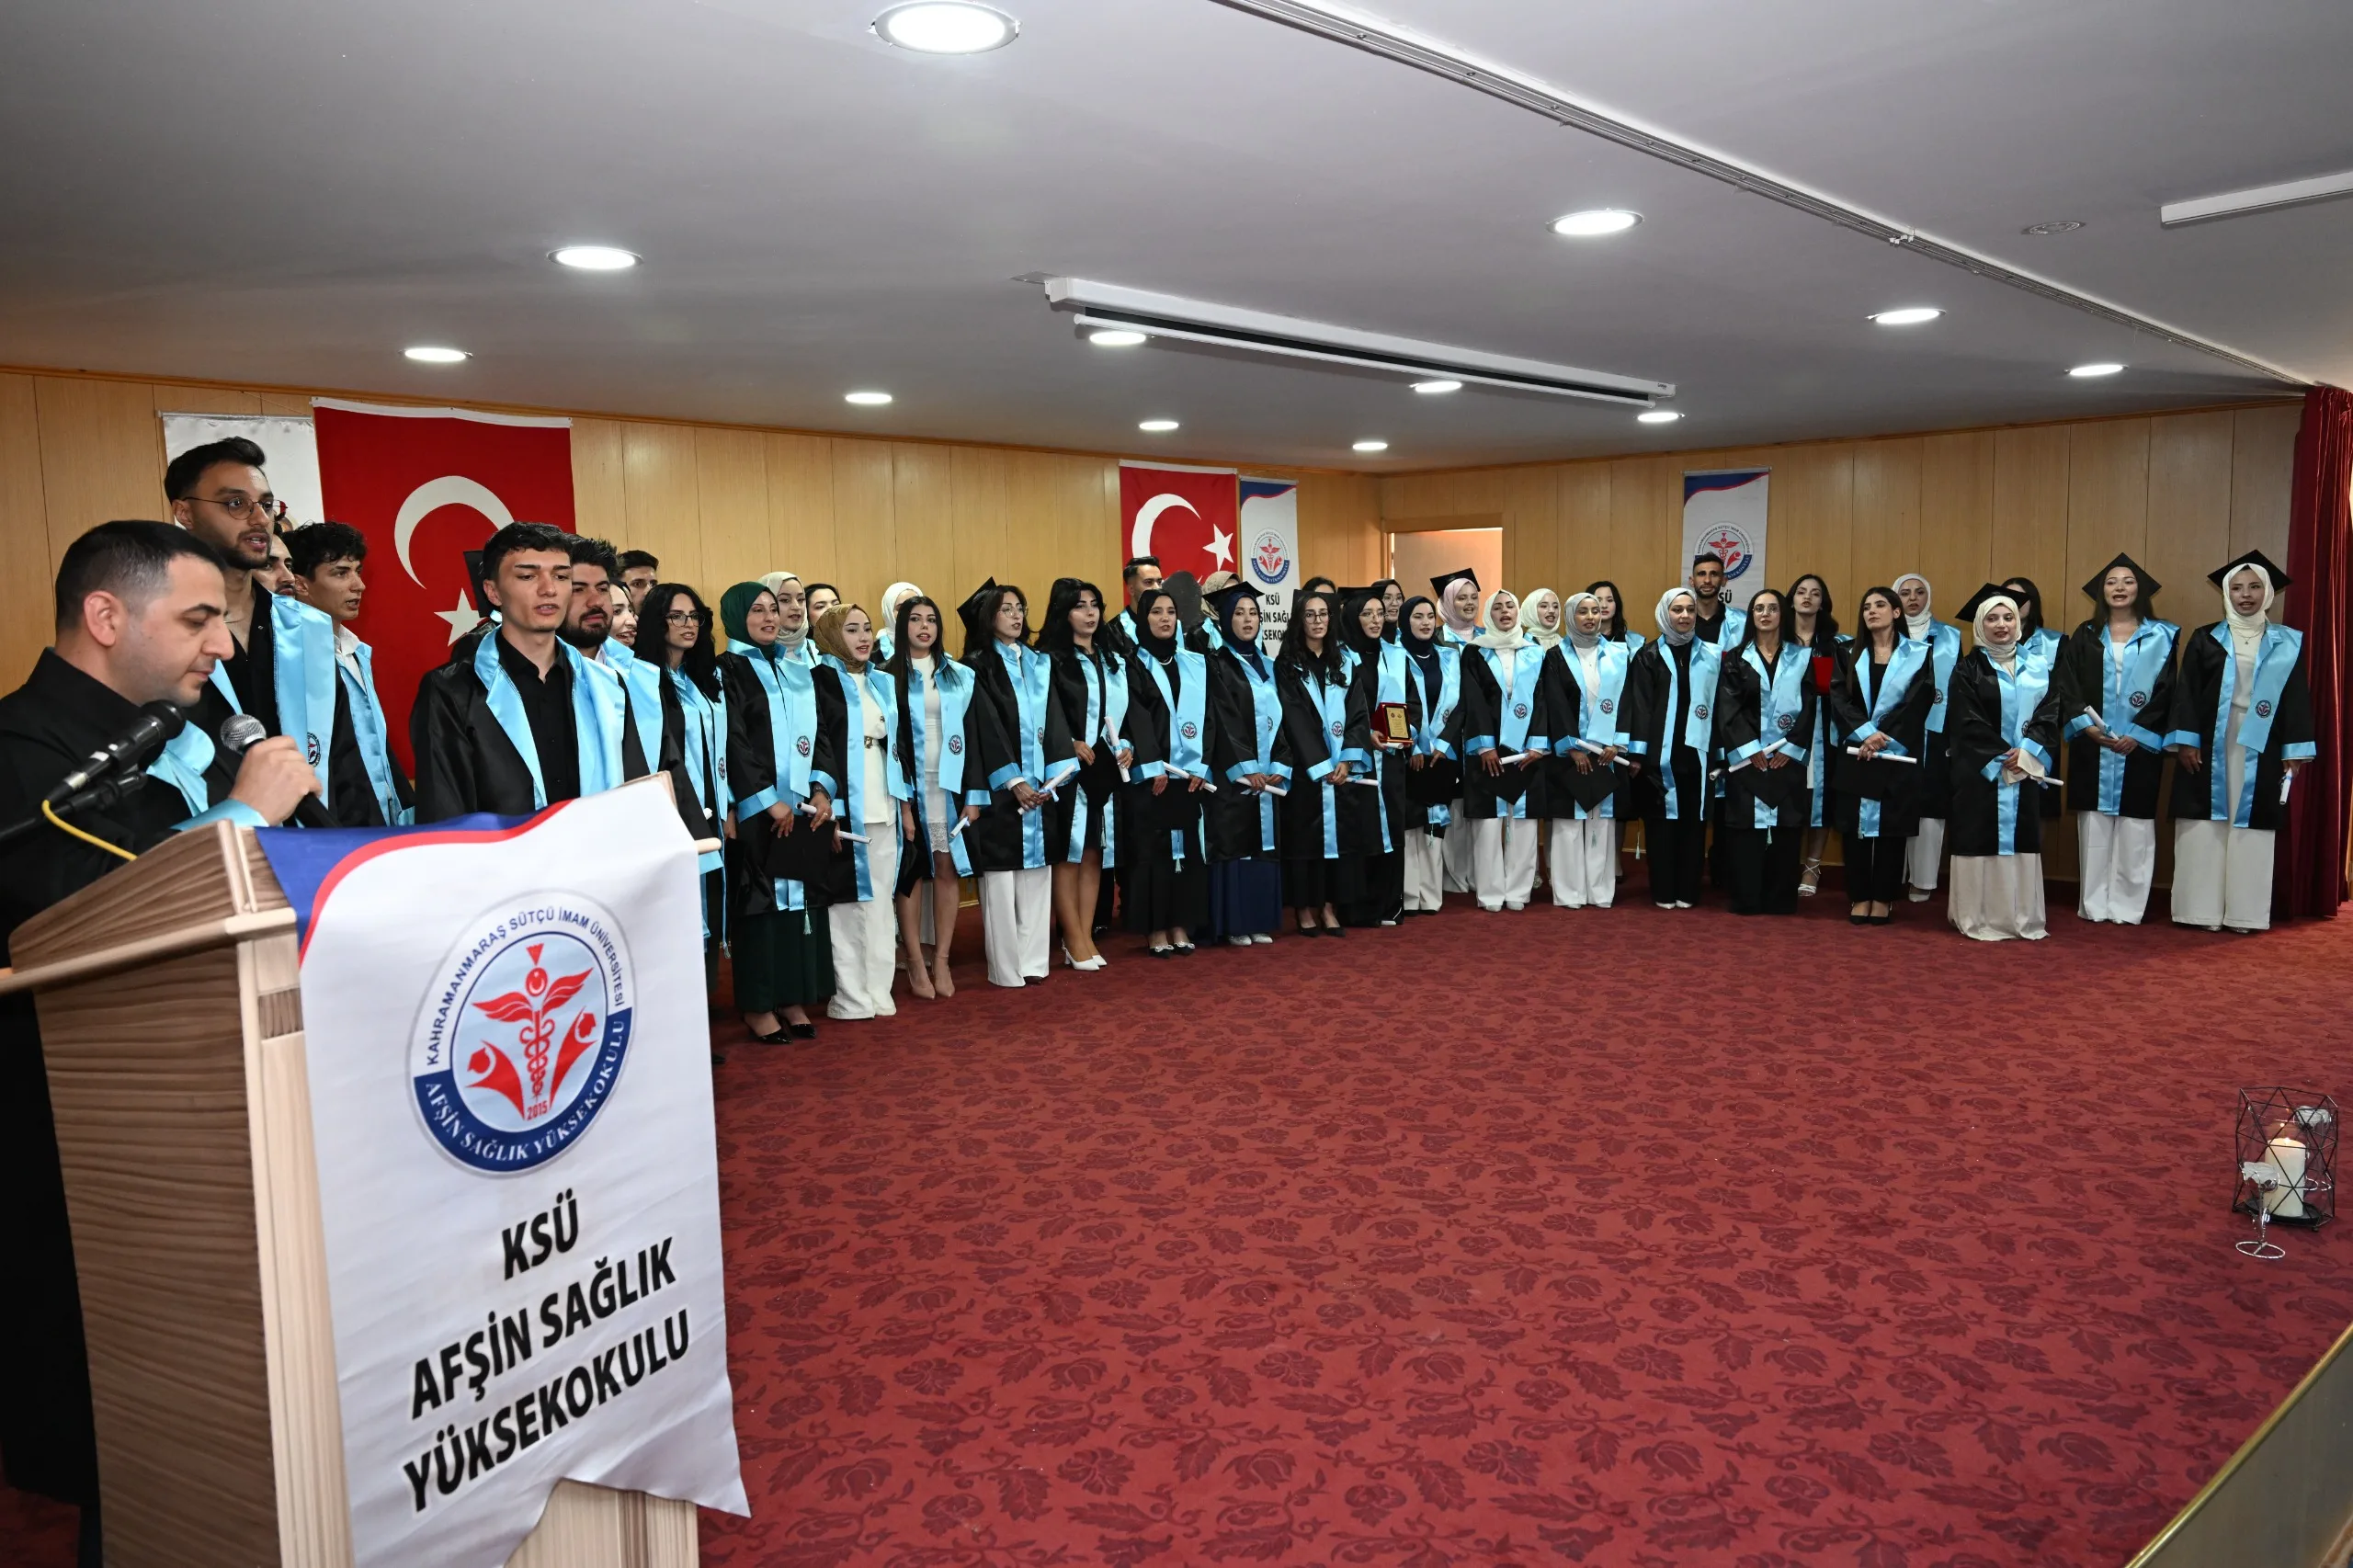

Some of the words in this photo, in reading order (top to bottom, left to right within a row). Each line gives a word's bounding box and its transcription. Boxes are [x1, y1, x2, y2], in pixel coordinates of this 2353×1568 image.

[1259, 608, 1271, 625] ŞİN
[1266, 592, 1280, 606] KSÜ
[1718, 589, 1732, 604] SÜ
[426, 925, 506, 1065] KAHRAMANMARAŞ
[509, 906, 555, 931] SÜTÇÜ
[558, 905, 589, 927] İMAM
[590, 920, 626, 1006] ÜNİVERSİTESİ
[426, 1082, 464, 1140] AFŞİN
[460, 1131, 529, 1161] SAĞLIK
[534, 1020, 625, 1155] YÜKSEKOKULU
[527, 1100, 548, 1121] 2015
[501, 1187, 578, 1281] KSÜ
[412, 1310, 533, 1421] AFŞİN
[540, 1236, 676, 1349] SAĞLIK
[403, 1308, 689, 1513] YÜKSEKOKULU
